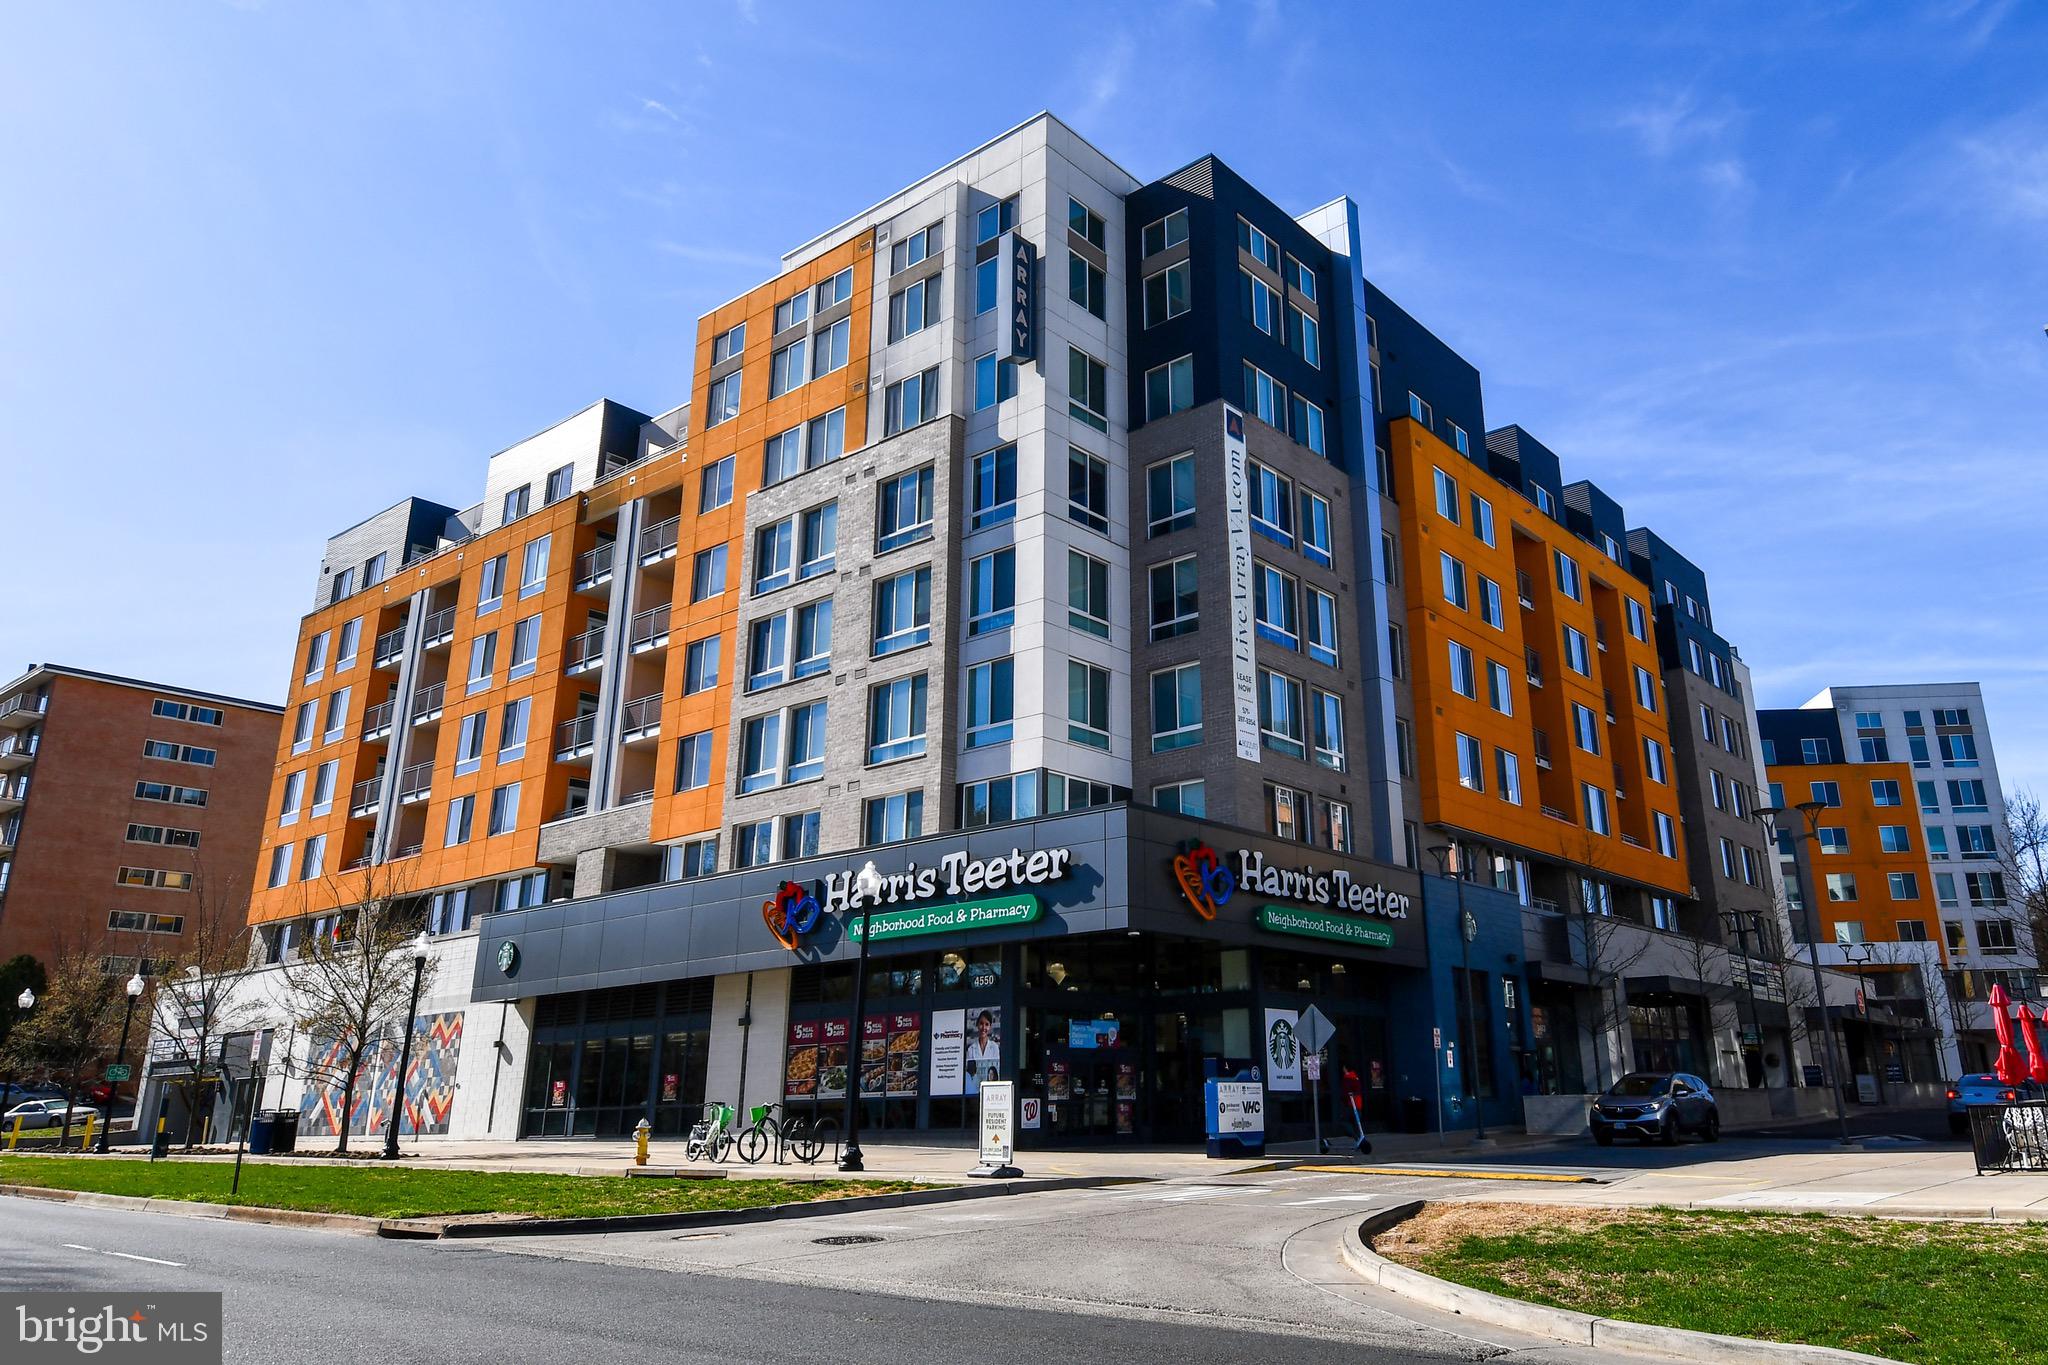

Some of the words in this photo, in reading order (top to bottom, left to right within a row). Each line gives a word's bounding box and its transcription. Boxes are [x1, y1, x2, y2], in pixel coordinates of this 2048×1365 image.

[1016, 245, 1029, 348] ARRAY
[1236, 671, 1252, 684] LEASE
[1237, 683, 1251, 694] NOW
[941, 848, 1069, 895] Teeter
[1239, 849, 1330, 904] Harris
[1332, 870, 1409, 919] Teeter
[853, 914, 925, 938] Neghborhood
[927, 911, 954, 927] Food
[956, 908, 968, 923] &
[970, 904, 1031, 920] Pharmacy
[1268, 911, 1324, 932] Neighborhood
[1325, 921, 1344, 935] Food
[1345, 923, 1353, 936] &
[1354, 925, 1391, 945] Pharmacy
[974, 975, 994, 986] 4550
[940, 1032, 963, 1040] Pharmacy
[986, 1094, 1007, 1102] ARRAY
